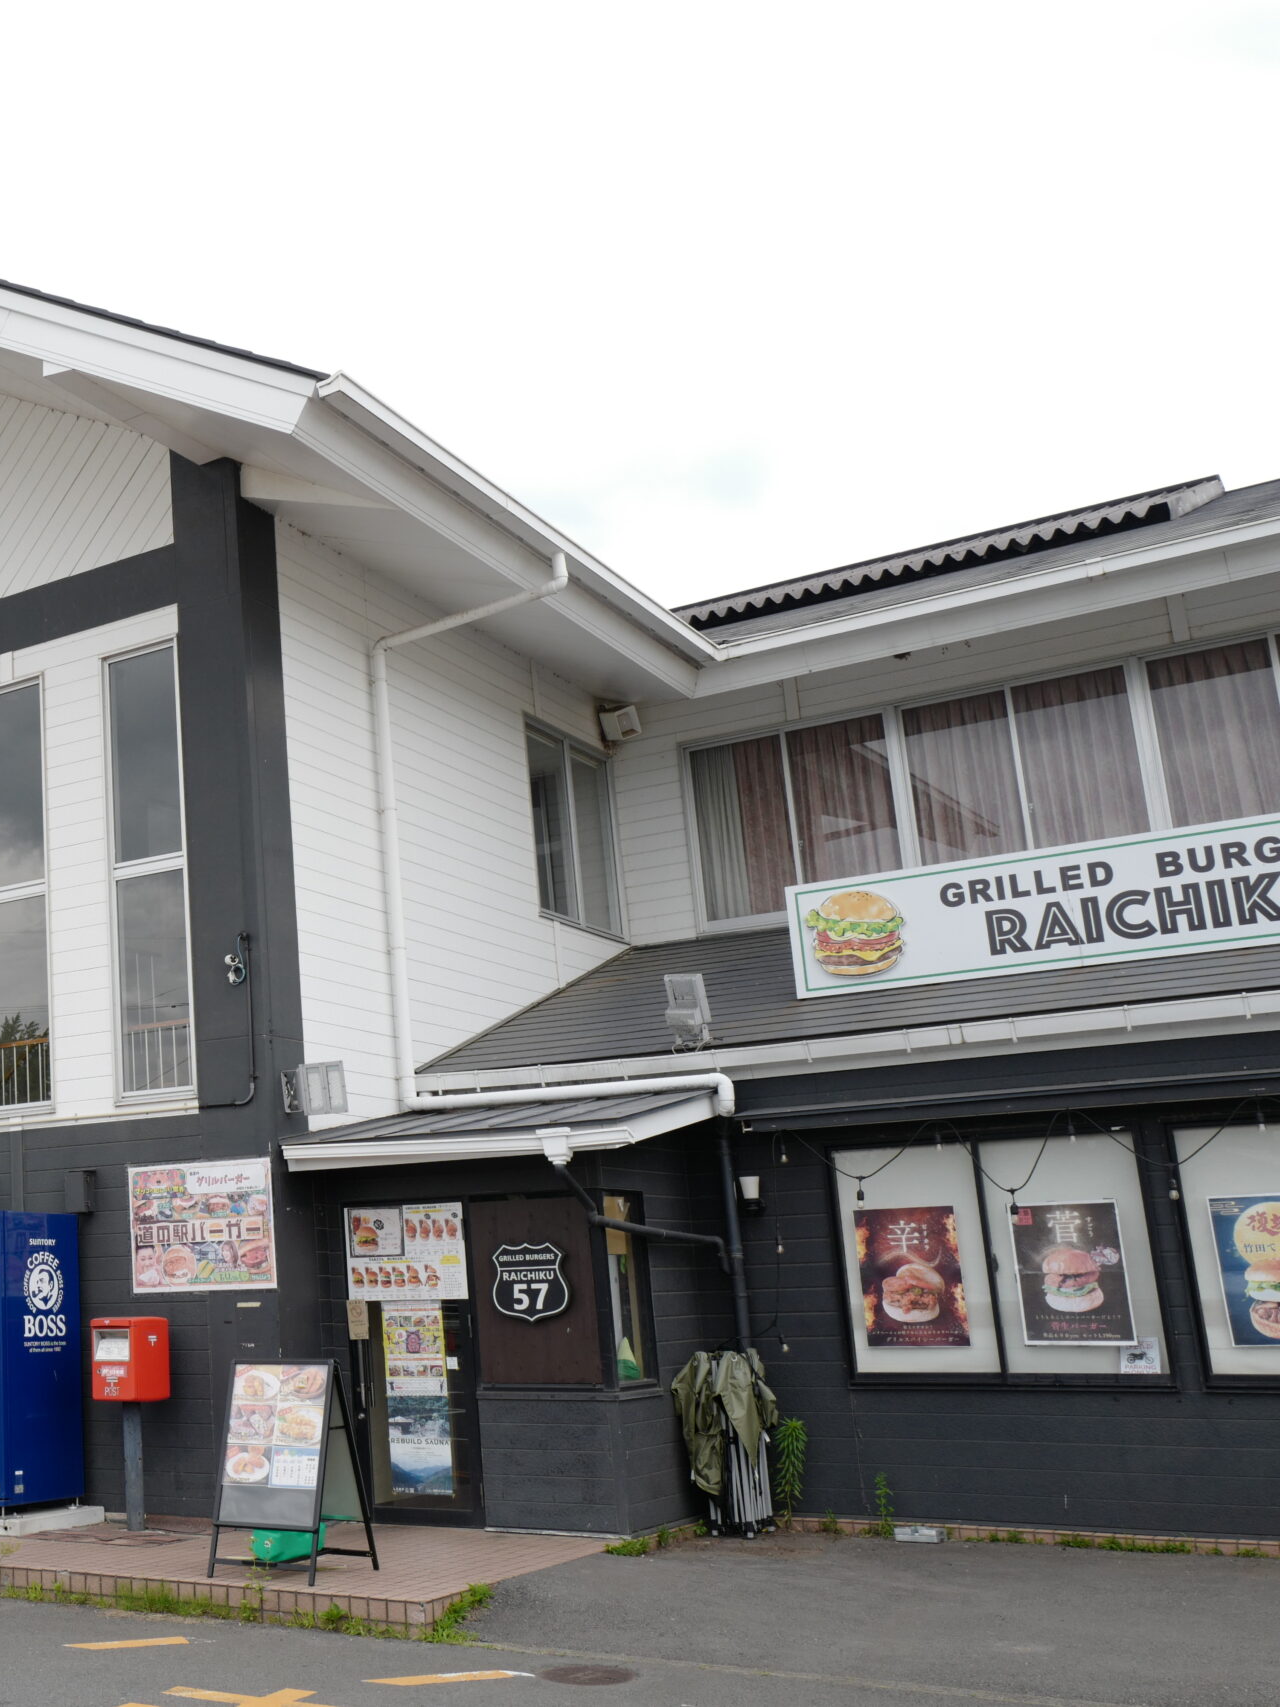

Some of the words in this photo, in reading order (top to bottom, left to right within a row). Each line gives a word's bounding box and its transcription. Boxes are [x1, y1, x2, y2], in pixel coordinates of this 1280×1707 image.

[938, 860, 1115, 909] GRILLED
[1155, 834, 1280, 879] BURG
[984, 870, 1280, 957] RAICHIK
[138, 1218, 261, 1243] 道の駅バーガー
[886, 1219, 920, 1253] 辛
[1046, 1210, 1081, 1243] 菅
[29, 1238, 56, 1246] SUNTORY
[27, 1251, 60, 1270] COFFEE
[498, 1254, 524, 1262] GRILLED
[525, 1253, 555, 1261] BURGERS
[502, 1270, 555, 1281] RAICHIKU
[513, 1282, 549, 1311] 57
[23, 1314, 67, 1338] BOSS
[104, 1386, 121, 1397] POST
